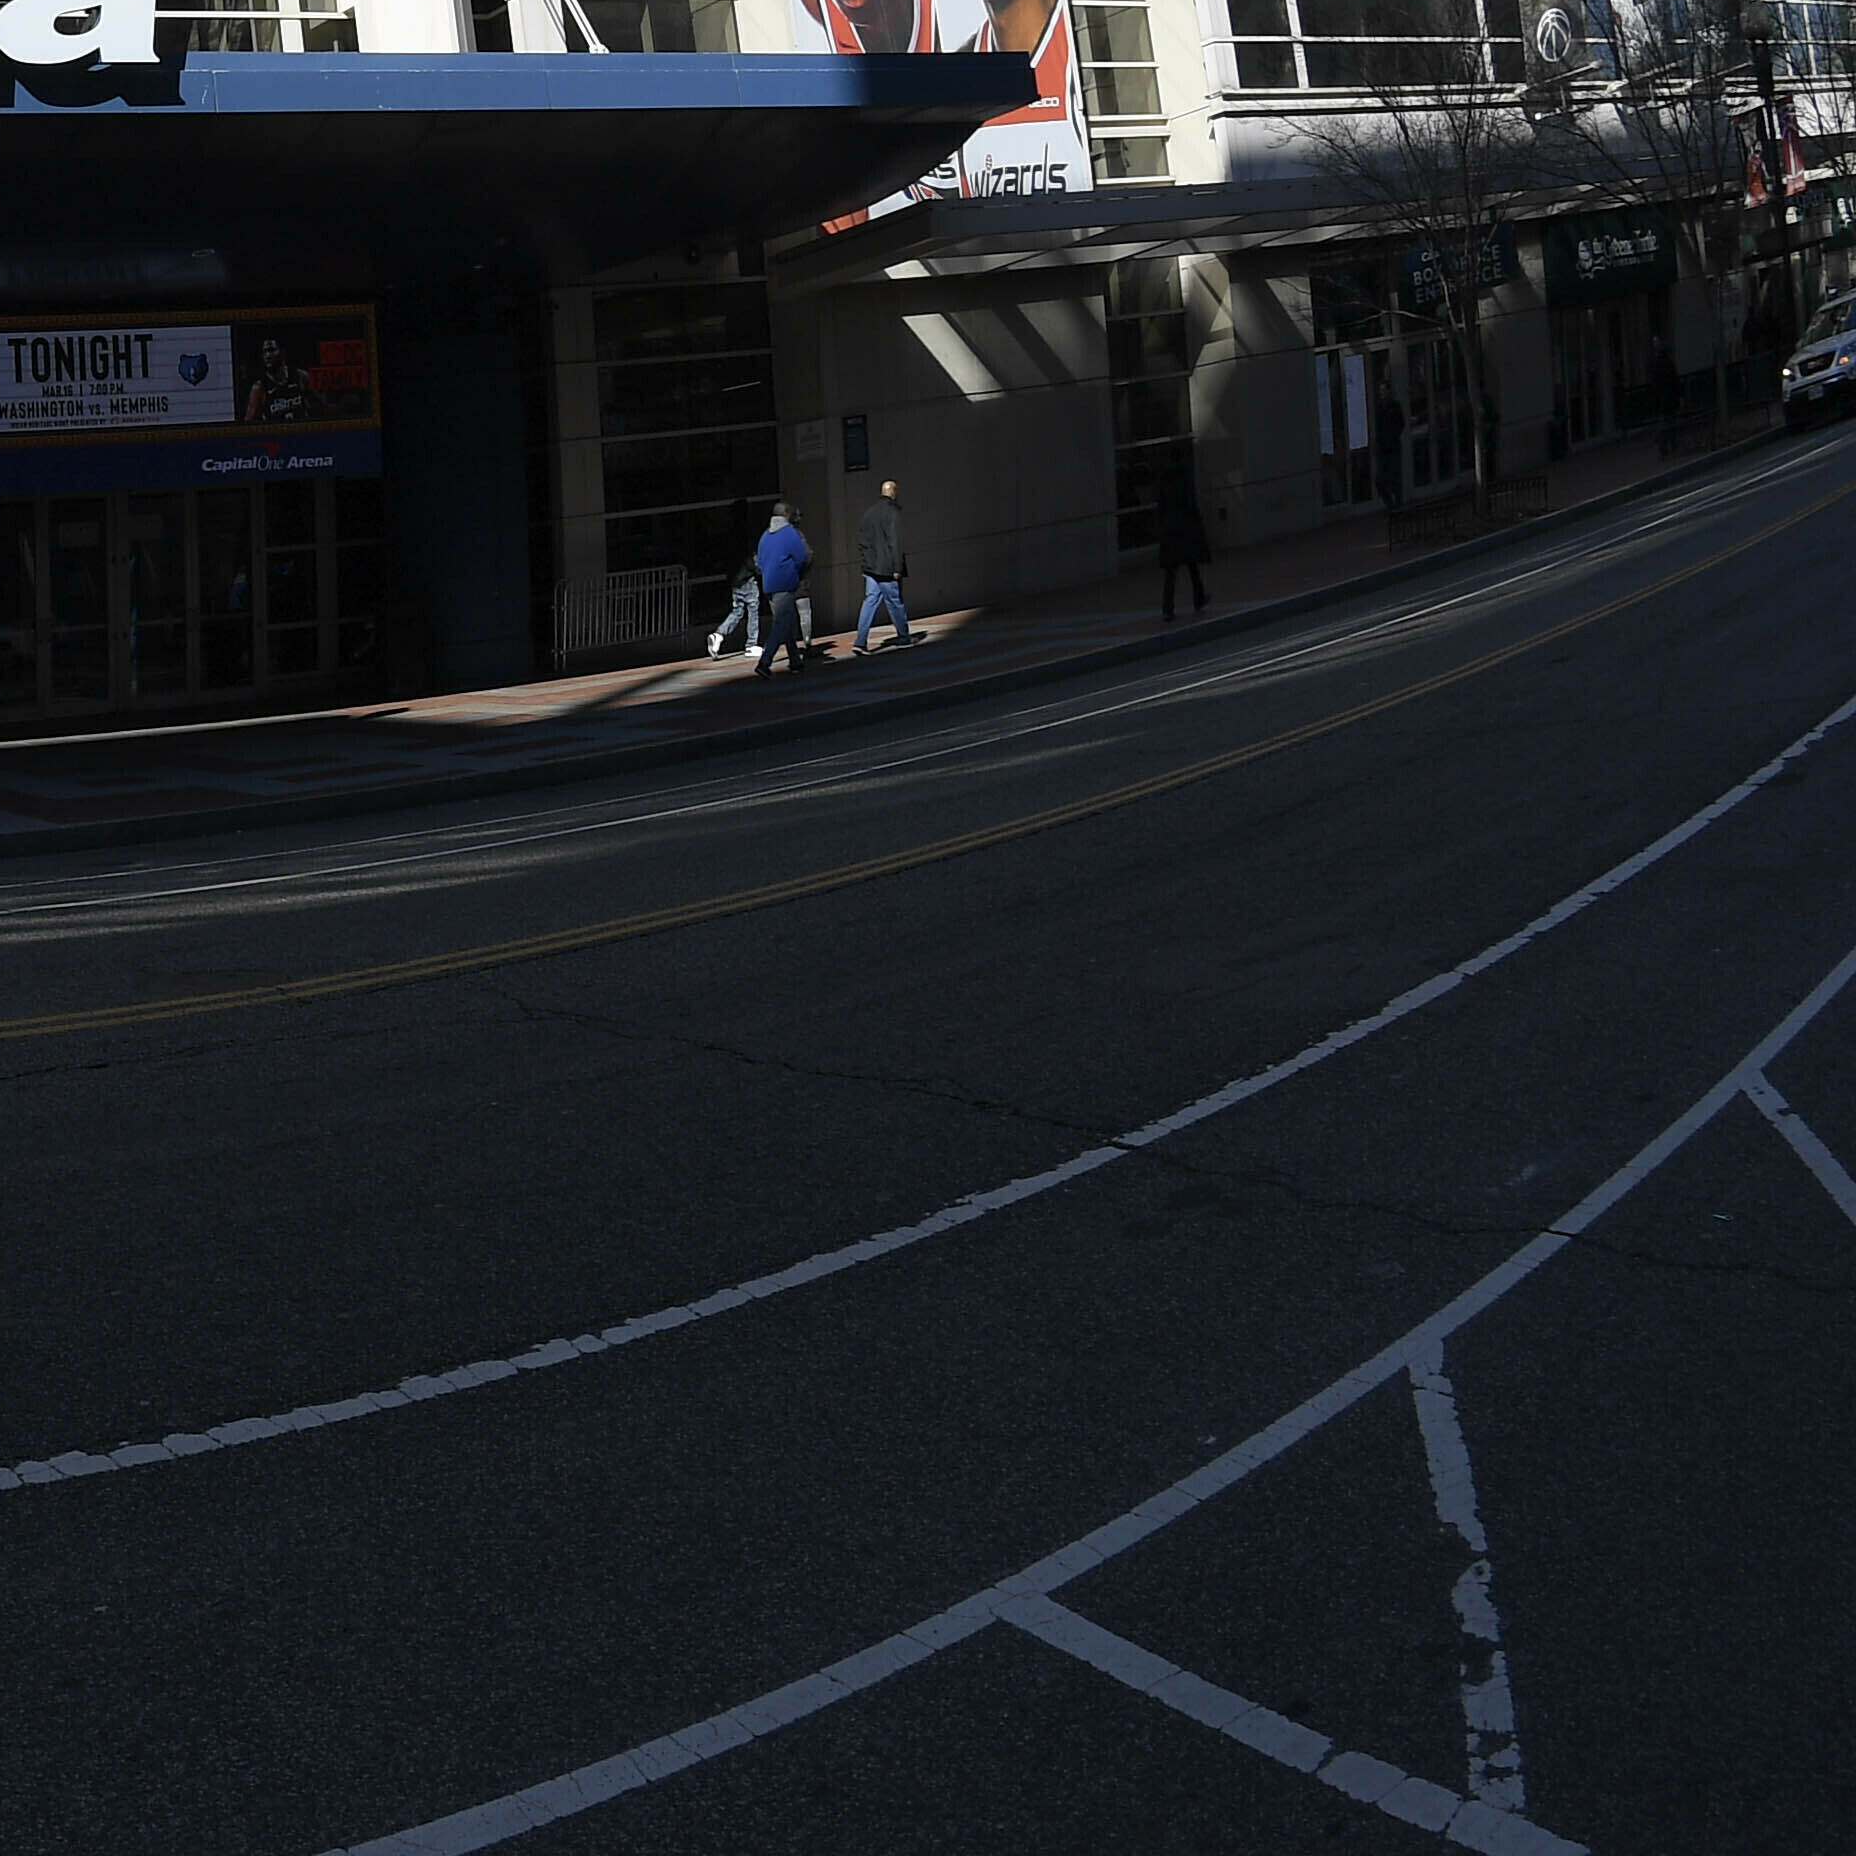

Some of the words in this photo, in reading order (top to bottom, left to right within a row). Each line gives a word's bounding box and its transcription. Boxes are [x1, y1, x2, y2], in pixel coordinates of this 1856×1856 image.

[970, 143, 1068, 198] wizards
[7, 334, 153, 383] TONIGHT
[110, 396, 169, 415] MEMPHIS
[288, 455, 334, 471] Arena
